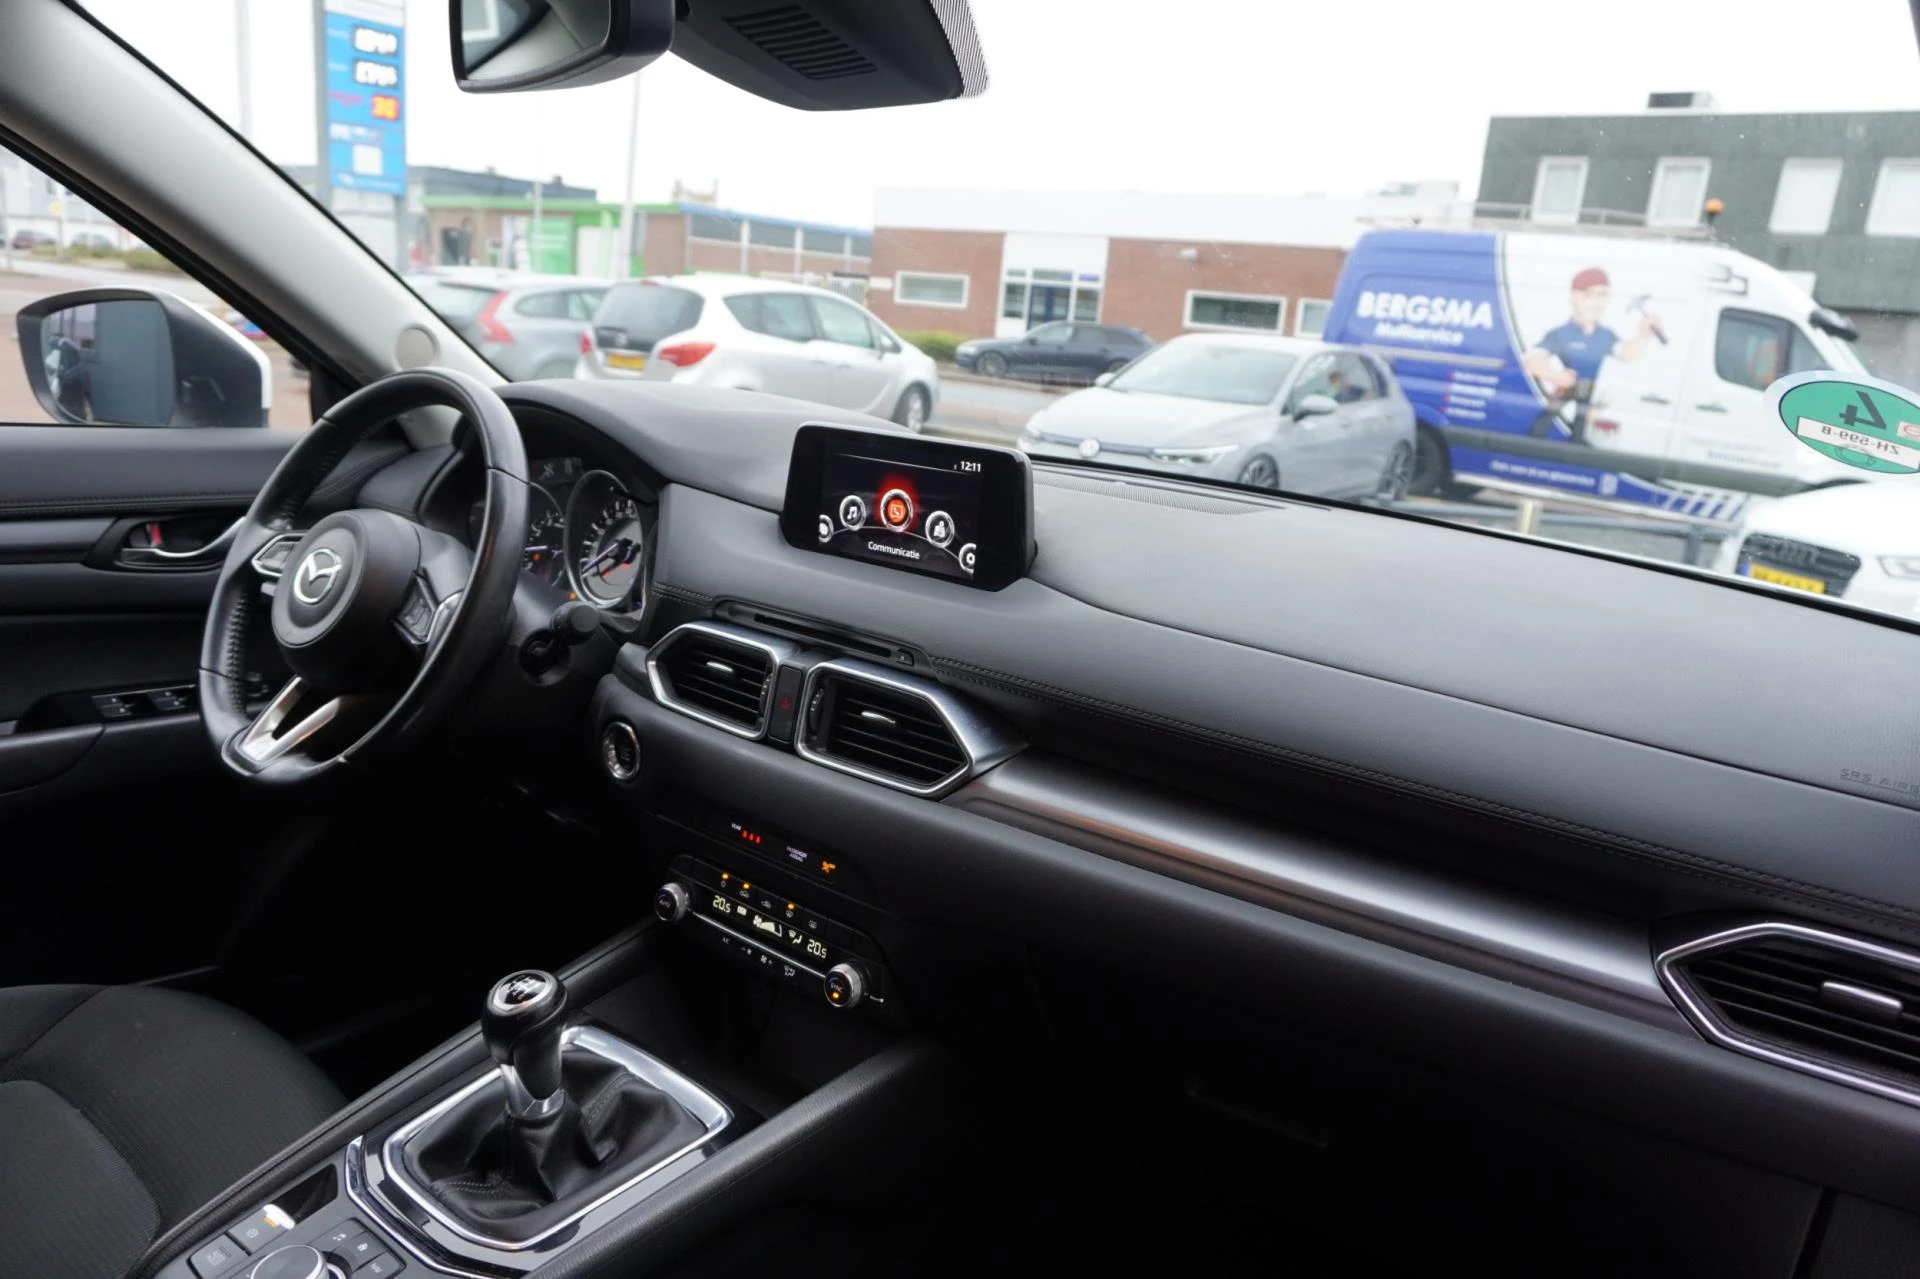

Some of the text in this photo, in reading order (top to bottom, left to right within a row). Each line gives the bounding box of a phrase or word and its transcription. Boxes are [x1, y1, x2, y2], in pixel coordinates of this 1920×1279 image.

[1357, 291, 1494, 330] BERGSMA
[960, 460, 982, 473] 12:11
[867, 540, 921, 560] Communicatie
[1840, 768, 1872, 782] SRS
[712, 894, 730, 913] 20.5
[807, 938, 827, 959] 20.5
